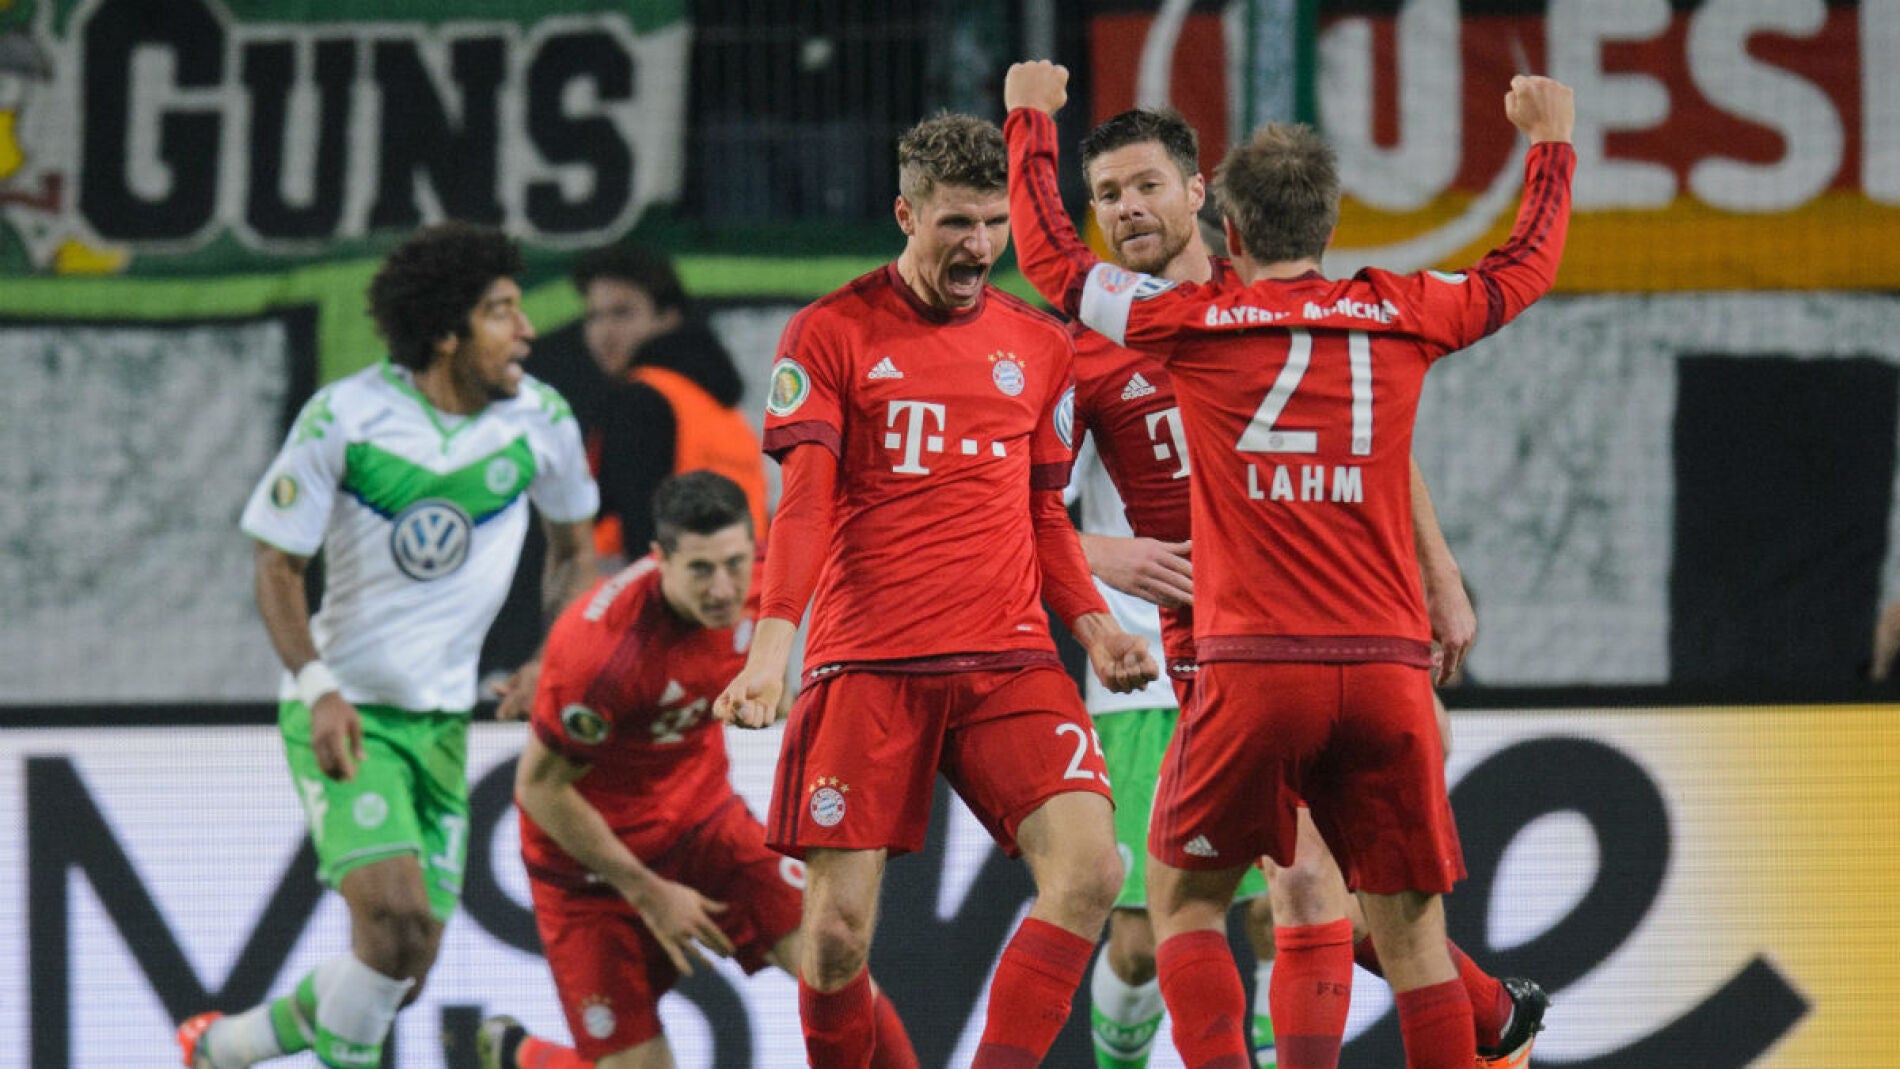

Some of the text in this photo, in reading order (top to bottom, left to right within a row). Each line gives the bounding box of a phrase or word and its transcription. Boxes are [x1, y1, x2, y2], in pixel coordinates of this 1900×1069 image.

[80, 0, 635, 240] GUNS
[1205, 304, 1291, 326] BAYER
[1236, 327, 1373, 456] 21
[1247, 463, 1363, 503] LAHM
